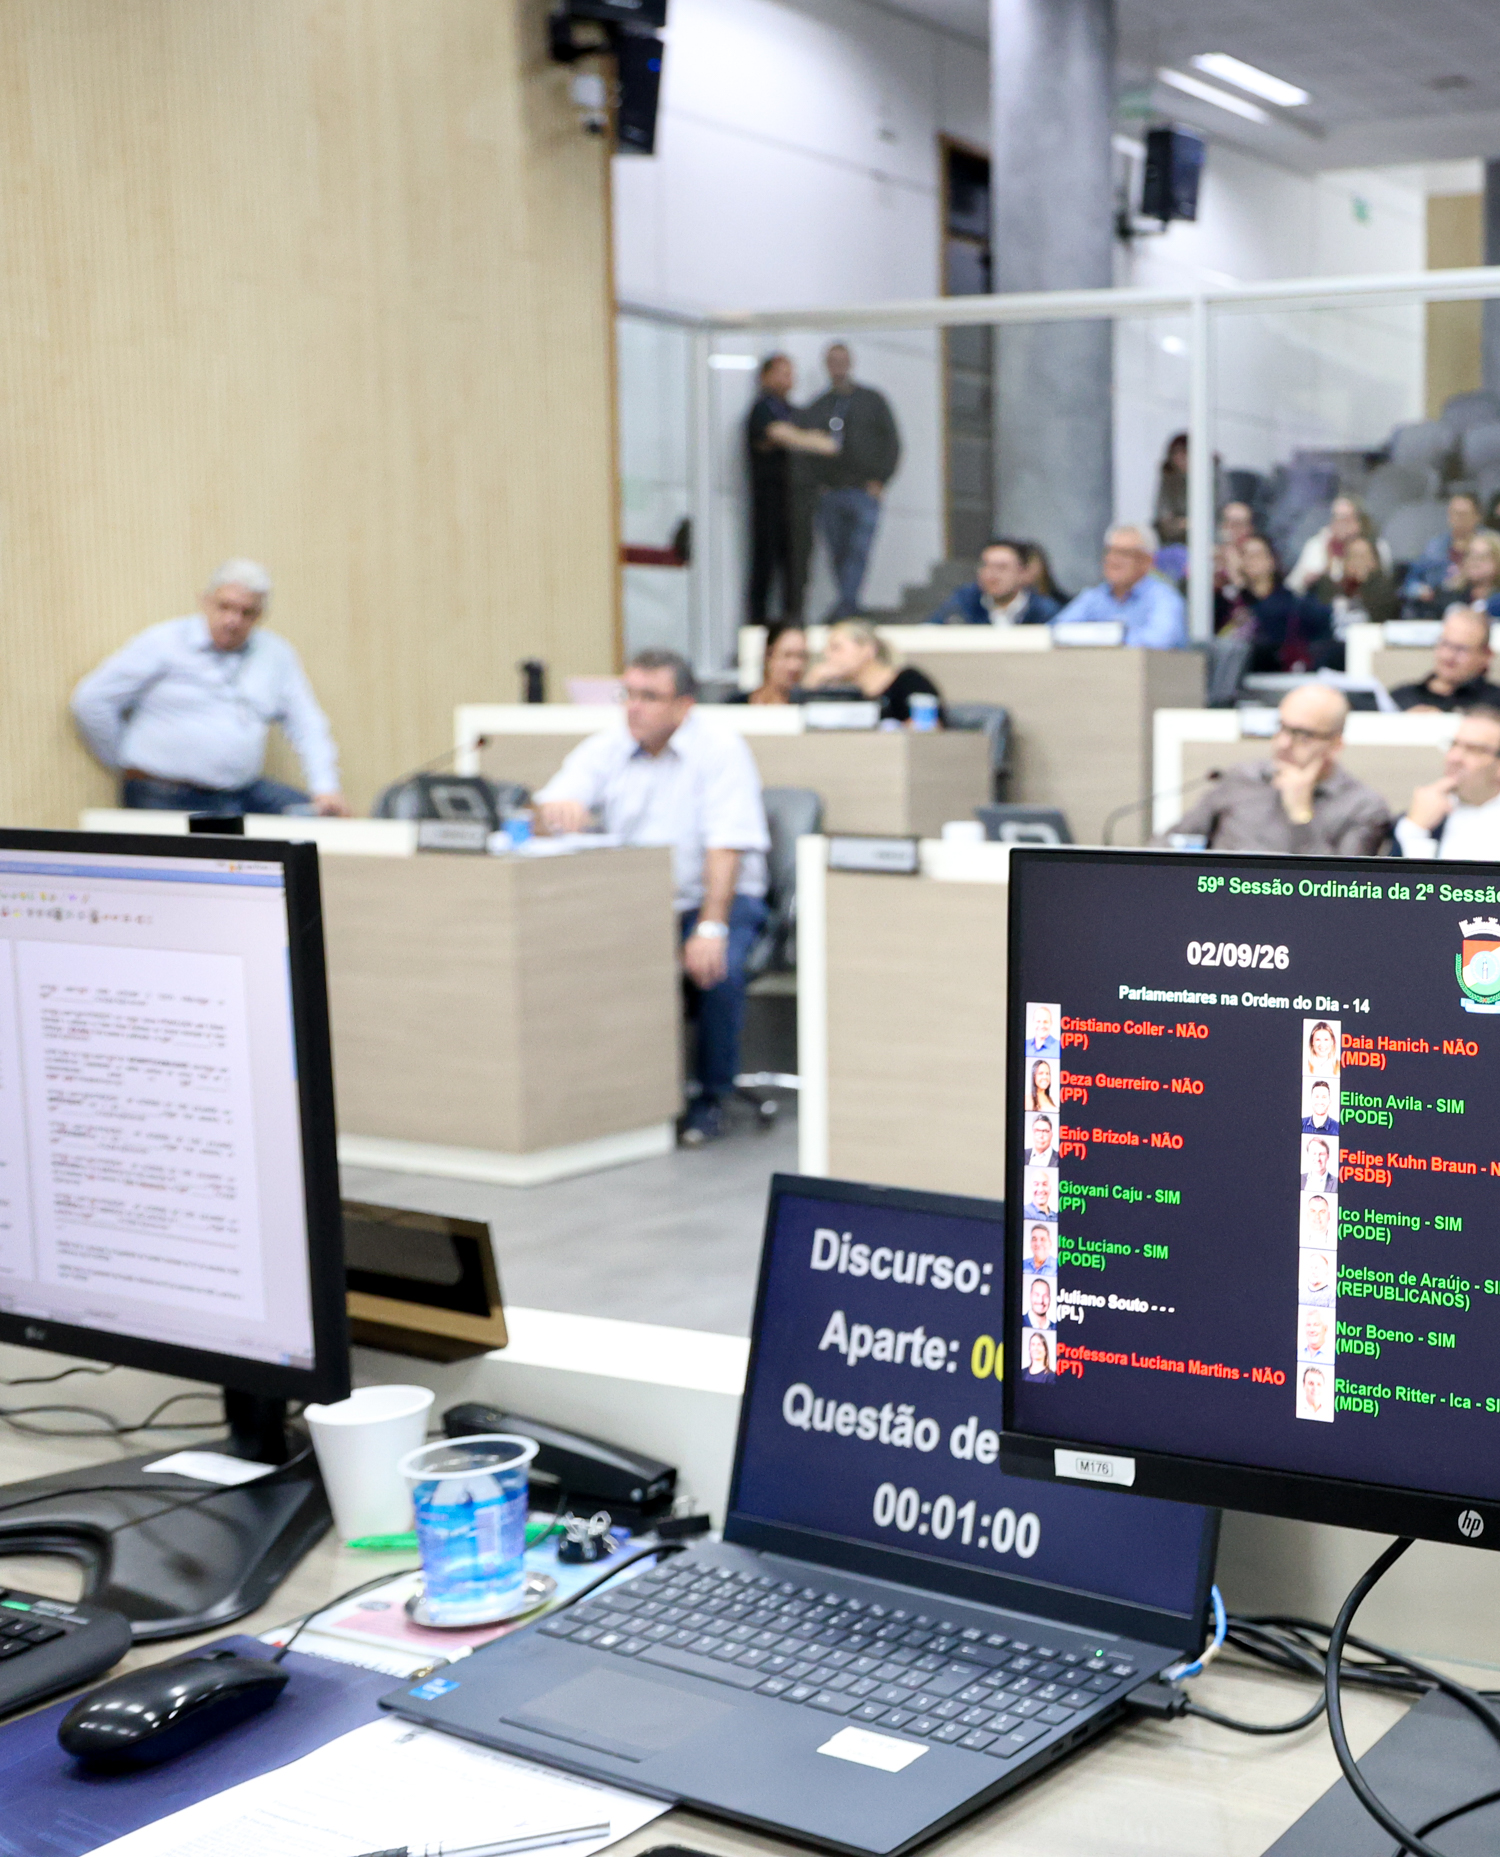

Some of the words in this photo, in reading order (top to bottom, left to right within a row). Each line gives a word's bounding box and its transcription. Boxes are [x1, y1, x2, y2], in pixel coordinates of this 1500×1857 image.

[1196, 876, 1225, 893] 59ª
[1229, 877, 1294, 896] Sessão
[1298, 879, 1383, 899] Ordinária
[1387, 882, 1410, 900] da
[1415, 883, 1434, 901] 2ª
[1186, 940, 1290, 970] 02/09/26
[1118, 985, 1217, 1005] Parlamentares
[1220, 991, 1238, 1005] na
[1241, 992, 1290, 1010] Ordem
[1292, 995, 1313, 1010] do
[1315, 996, 1340, 1012] Dia
[1352, 998, 1370, 1014] 14
[1060, 1015, 1121, 1034] Cristiano
[1123, 1020, 1165, 1036] Coller
[1176, 1022, 1209, 1039] NÃO
[1060, 1032, 1090, 1051] (PP)
[1340, 1033, 1374, 1050] Daia
[1377, 1035, 1430, 1054] Hanich
[1442, 1038, 1479, 1057] NÃO
[1340, 1051, 1387, 1071] (MDB)
[1059, 1070, 1093, 1087] Deza
[1095, 1073, 1160, 1092] Guerreiro
[1171, 1077, 1204, 1095] NÃO
[1060, 1087, 1088, 1105] (PP)
[1340, 1091, 1382, 1108] Eliton
[1385, 1094, 1423, 1111] Avila
[1436, 1098, 1465, 1115] SIM
[1340, 1108, 1394, 1129] (PODE)
[1059, 1125, 1090, 1141] Enio
[1092, 1127, 1140, 1146] Brizola
[1151, 1132, 1184, 1150] NÃO
[1058, 1142, 1087, 1160] (PT)
[1338, 1148, 1384, 1168] Felipe
[1386, 1152, 1427, 1170] Kuhn
[1430, 1156, 1477, 1175] Braun
[1338, 1166, 1392, 1188] (PSDB)
[1058, 1180, 1109, 1199] Giovani
[1112, 1185, 1143, 1204] Caju
[1154, 1189, 1181, 1205] SIM
[1058, 1196, 1086, 1215] (PP)
[1338, 1206, 1360, 1222] Ico
[1364, 1208, 1421, 1231] Heming
[1434, 1215, 1463, 1232] SIM
[1058, 1234, 1075, 1249] Ito
[1078, 1237, 1131, 1255] Luciano
[1143, 1243, 1169, 1259] SIM
[1337, 1223, 1392, 1245] (PODE)
[809, 1227, 993, 1296] Discurso:
[1057, 1251, 1106, 1271] (PODE)
[1337, 1264, 1394, 1284] Joelson
[1398, 1271, 1417, 1286] de
[1420, 1272, 1471, 1294] Araújo
[1056, 1288, 1106, 1308] Juliano
[1108, 1294, 1149, 1313] Souto
[1336, 1280, 1471, 1312] (REPUBLICANOS)
[1056, 1304, 1084, 1324] (PL)
[818, 1309, 960, 1374] Aparte:
[1335, 1320, 1362, 1338] Nor
[1366, 1324, 1414, 1343] Boeno
[1427, 1331, 1456, 1348] SIM
[1335, 1338, 1381, 1360] (MDB)
[1056, 1342, 1128, 1365] Professora
[1131, 1352, 1185, 1373] Luciana
[1188, 1359, 1240, 1380] Martins
[1251, 1367, 1286, 1386] NÃO
[1056, 1359, 1084, 1379] (PT)
[1334, 1395, 1380, 1418] (MDB)
[1335, 1378, 1392, 1399] Ricardo
[1395, 1385, 1436, 1405] Ritter
[1449, 1392, 1472, 1410] Ica
[781, 1381, 940, 1453] Questão
[949, 1415, 1000, 1465] de
[1080, 1461, 1109, 1475] M176
[872, 1481, 1041, 1559] 00:01:00
[1460, 1509, 1482, 1538] hp
